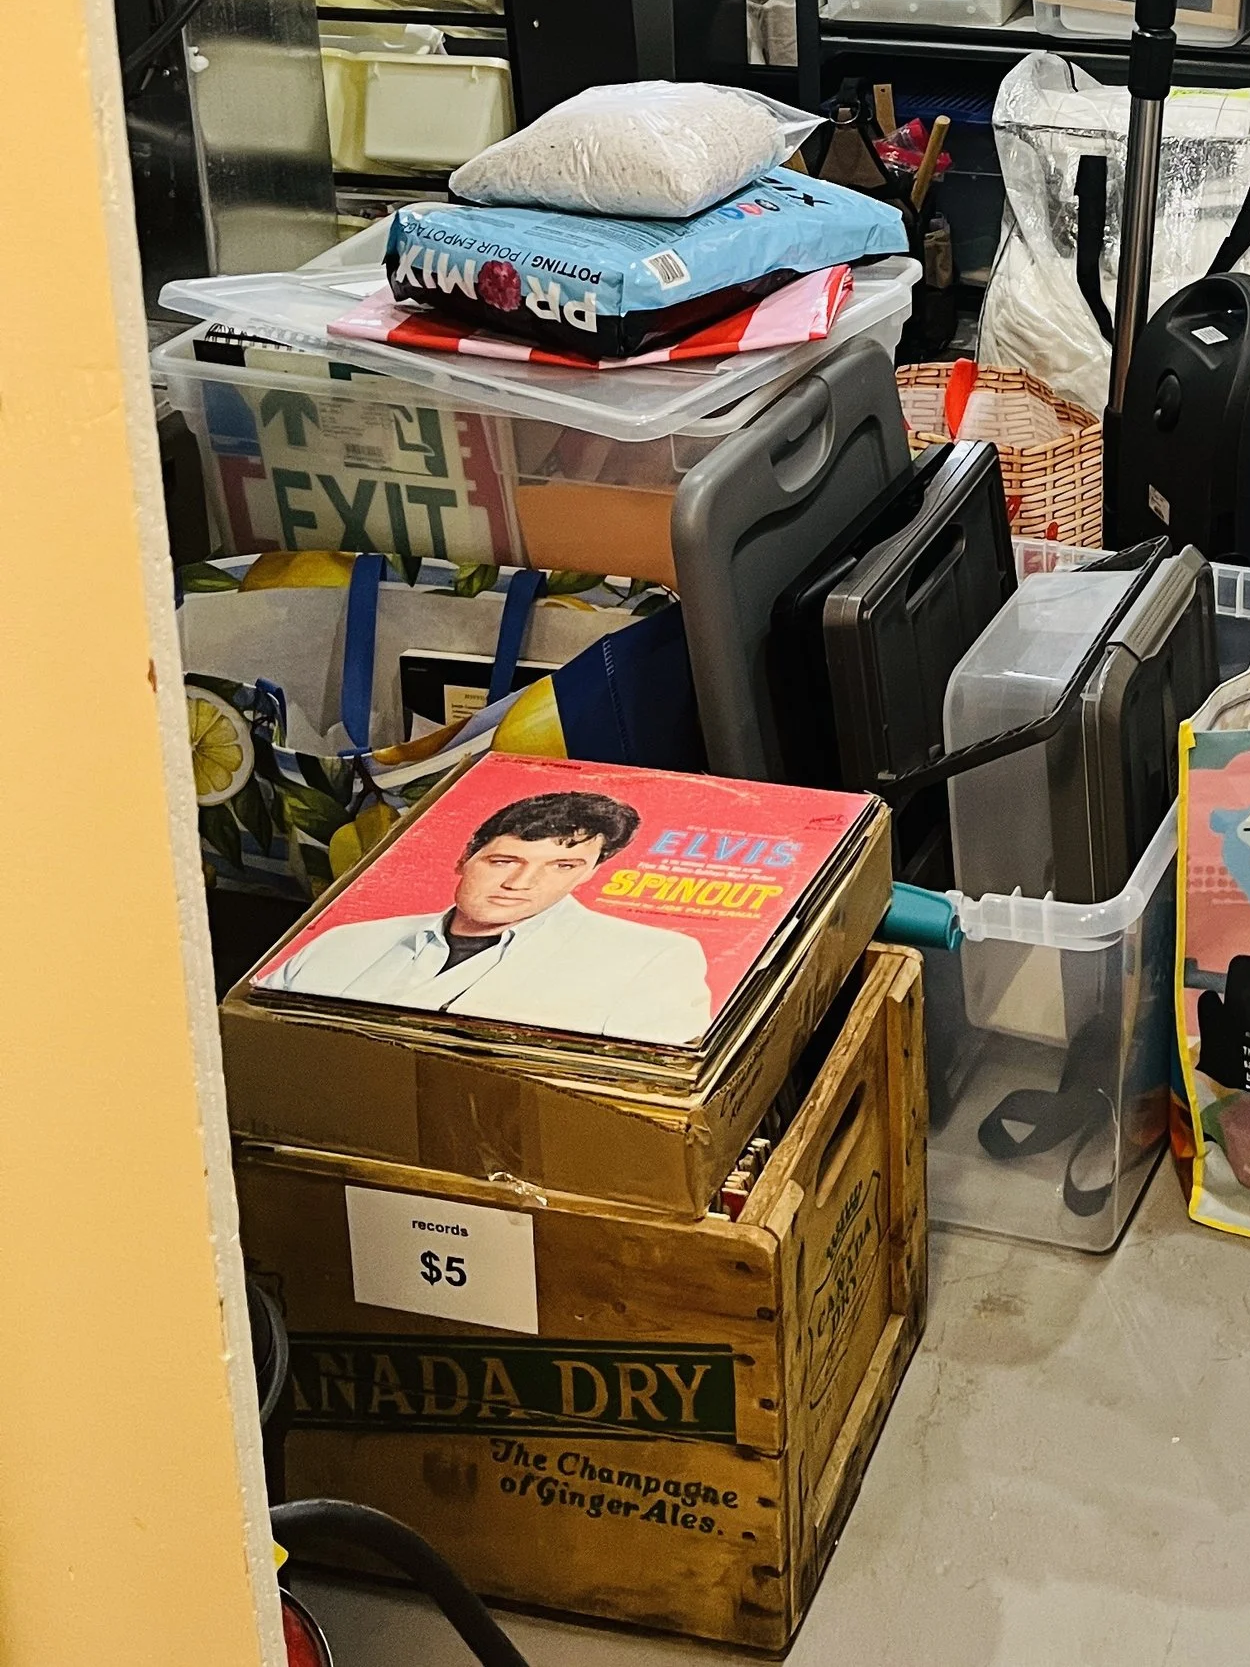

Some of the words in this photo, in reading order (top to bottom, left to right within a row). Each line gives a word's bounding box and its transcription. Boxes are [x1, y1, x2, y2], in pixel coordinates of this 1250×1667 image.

[477, 239, 522, 263] POUR
[531, 255, 602, 285] POTTING
[272, 466, 459, 560] EXIT
[649, 828, 799, 868] ELVIS
[411, 1219, 470, 1238] records
[420, 1249, 468, 1288] $5
[551, 1358, 712, 1425] DRY
[490, 1436, 549, 1473] The
[556, 1450, 740, 1511] Champagne
[500, 1472, 538, 1499] of
[537, 1477, 640, 1520] Ginger
[639, 1499, 724, 1538] Ales.
